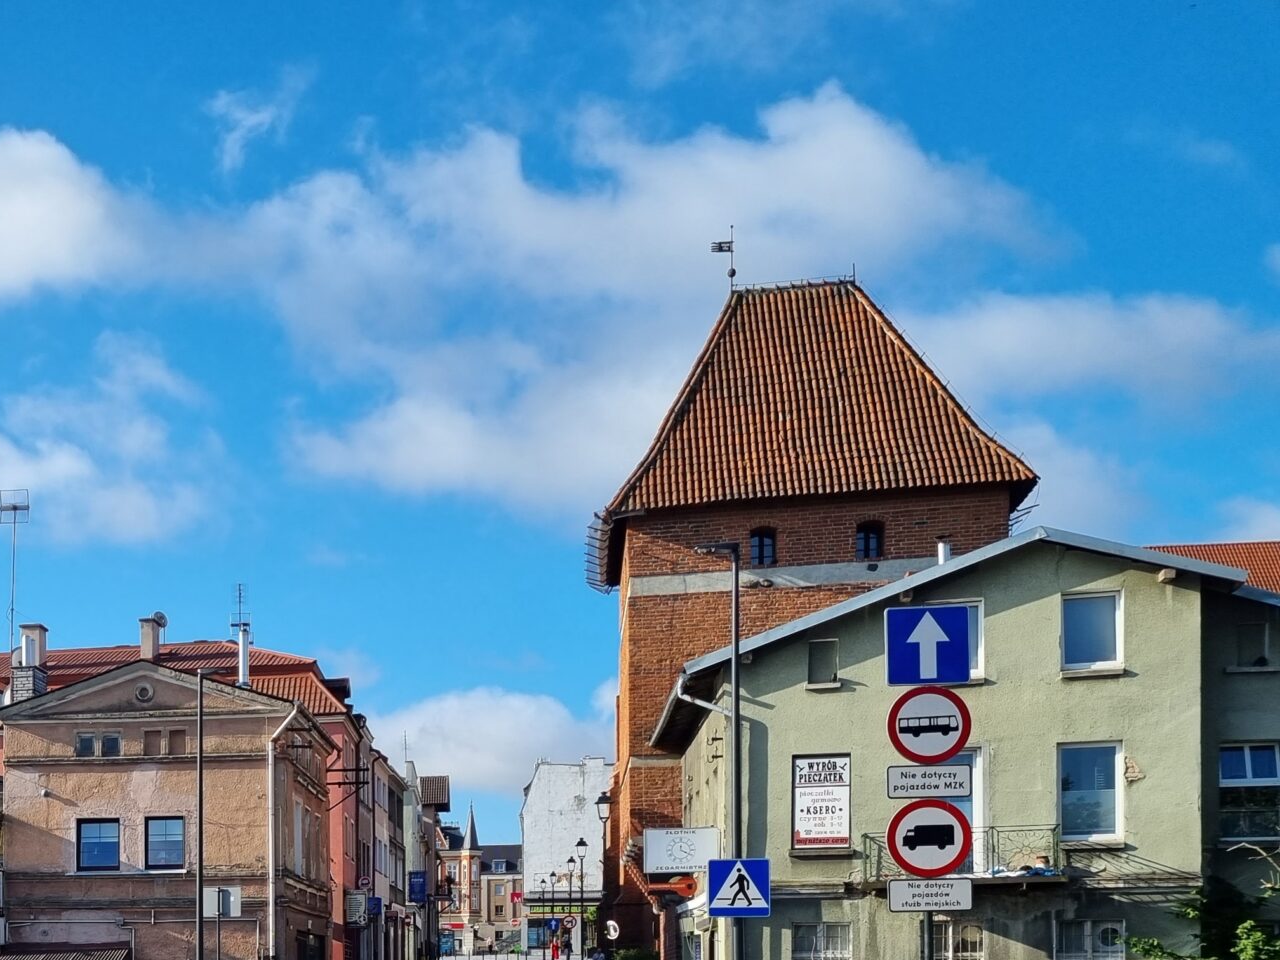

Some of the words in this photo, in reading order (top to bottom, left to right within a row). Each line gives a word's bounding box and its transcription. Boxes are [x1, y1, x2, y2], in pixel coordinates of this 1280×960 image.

[808, 760, 837, 771] WYRÓB
[900, 771, 916, 779] Nie
[921, 771, 957, 780] dotyczy
[893, 782, 940, 793] pojazdów
[944, 781, 965, 790] MZK
[806, 805, 837, 815] KSERO
[924, 882, 954, 890] dotyczy
[912, 891, 950, 899] pojazdów
[924, 900, 961, 909] miejskich
